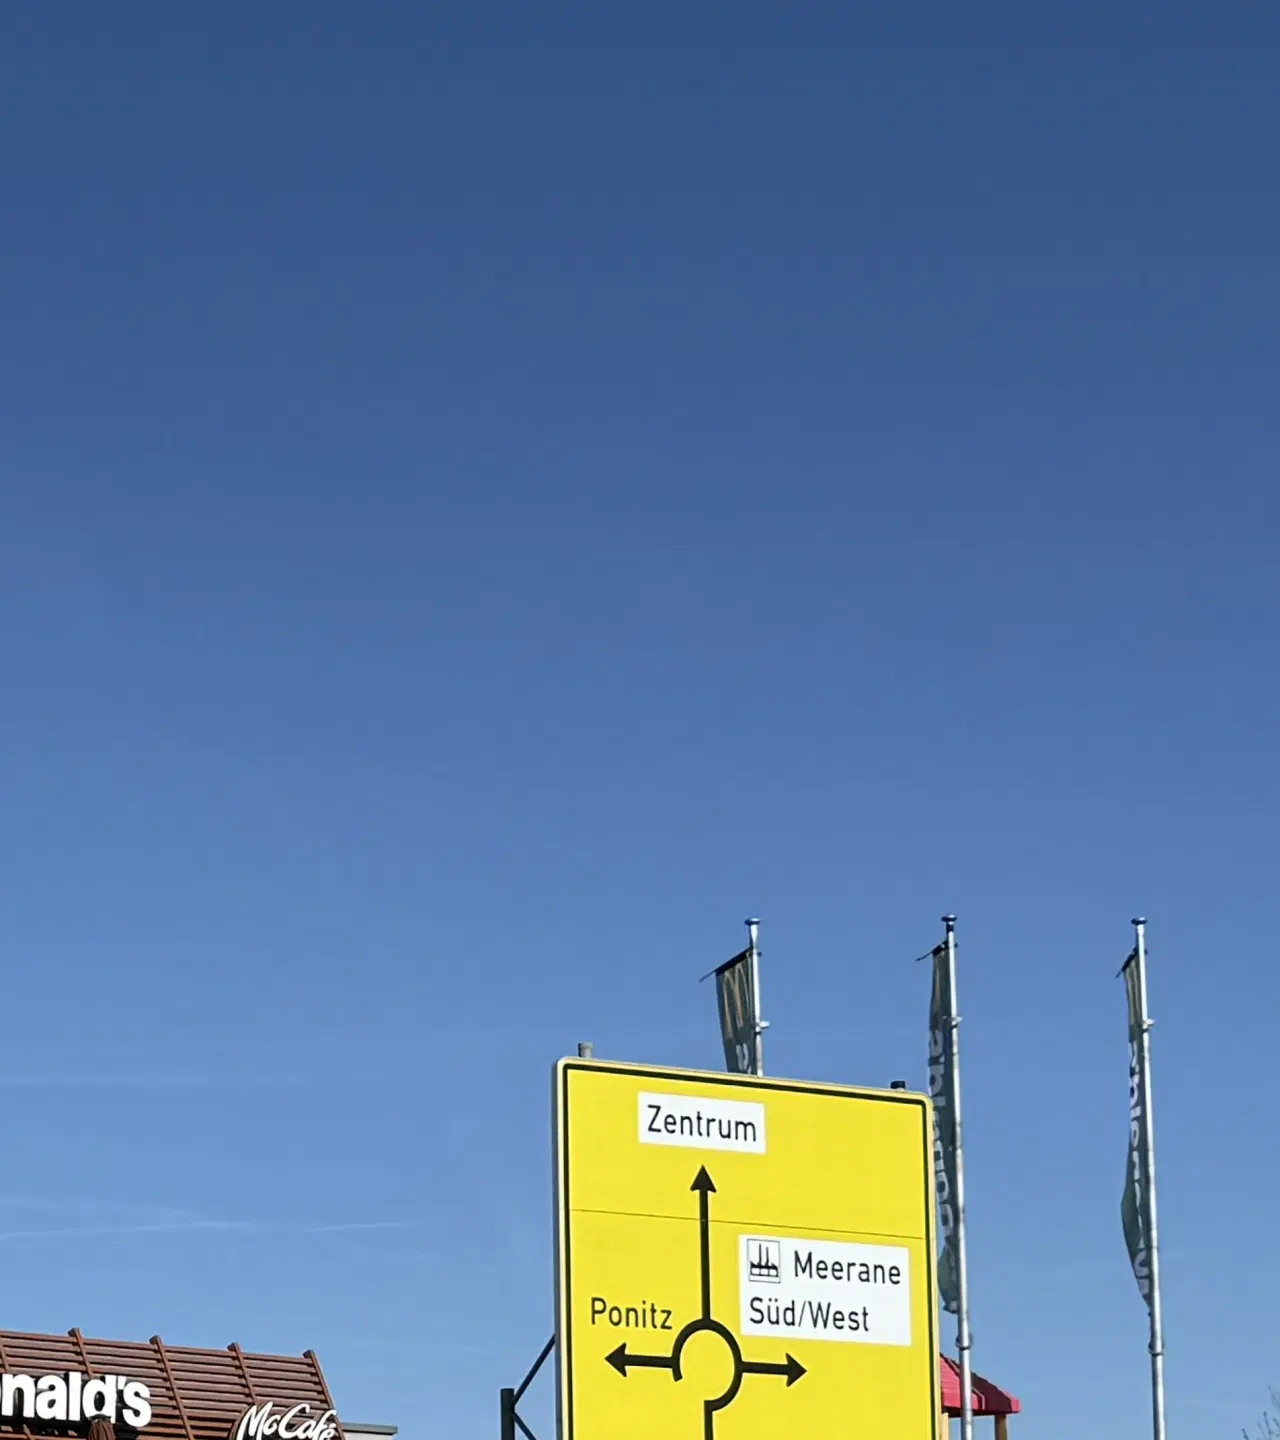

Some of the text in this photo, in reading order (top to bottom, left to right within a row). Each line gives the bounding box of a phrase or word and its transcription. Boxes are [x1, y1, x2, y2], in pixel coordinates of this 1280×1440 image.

[647, 1104, 757, 1142] Zentrum
[794, 1250, 901, 1285] Meerane
[591, 1297, 673, 1330] Ponitz
[749, 1297, 870, 1332] Süd/West
